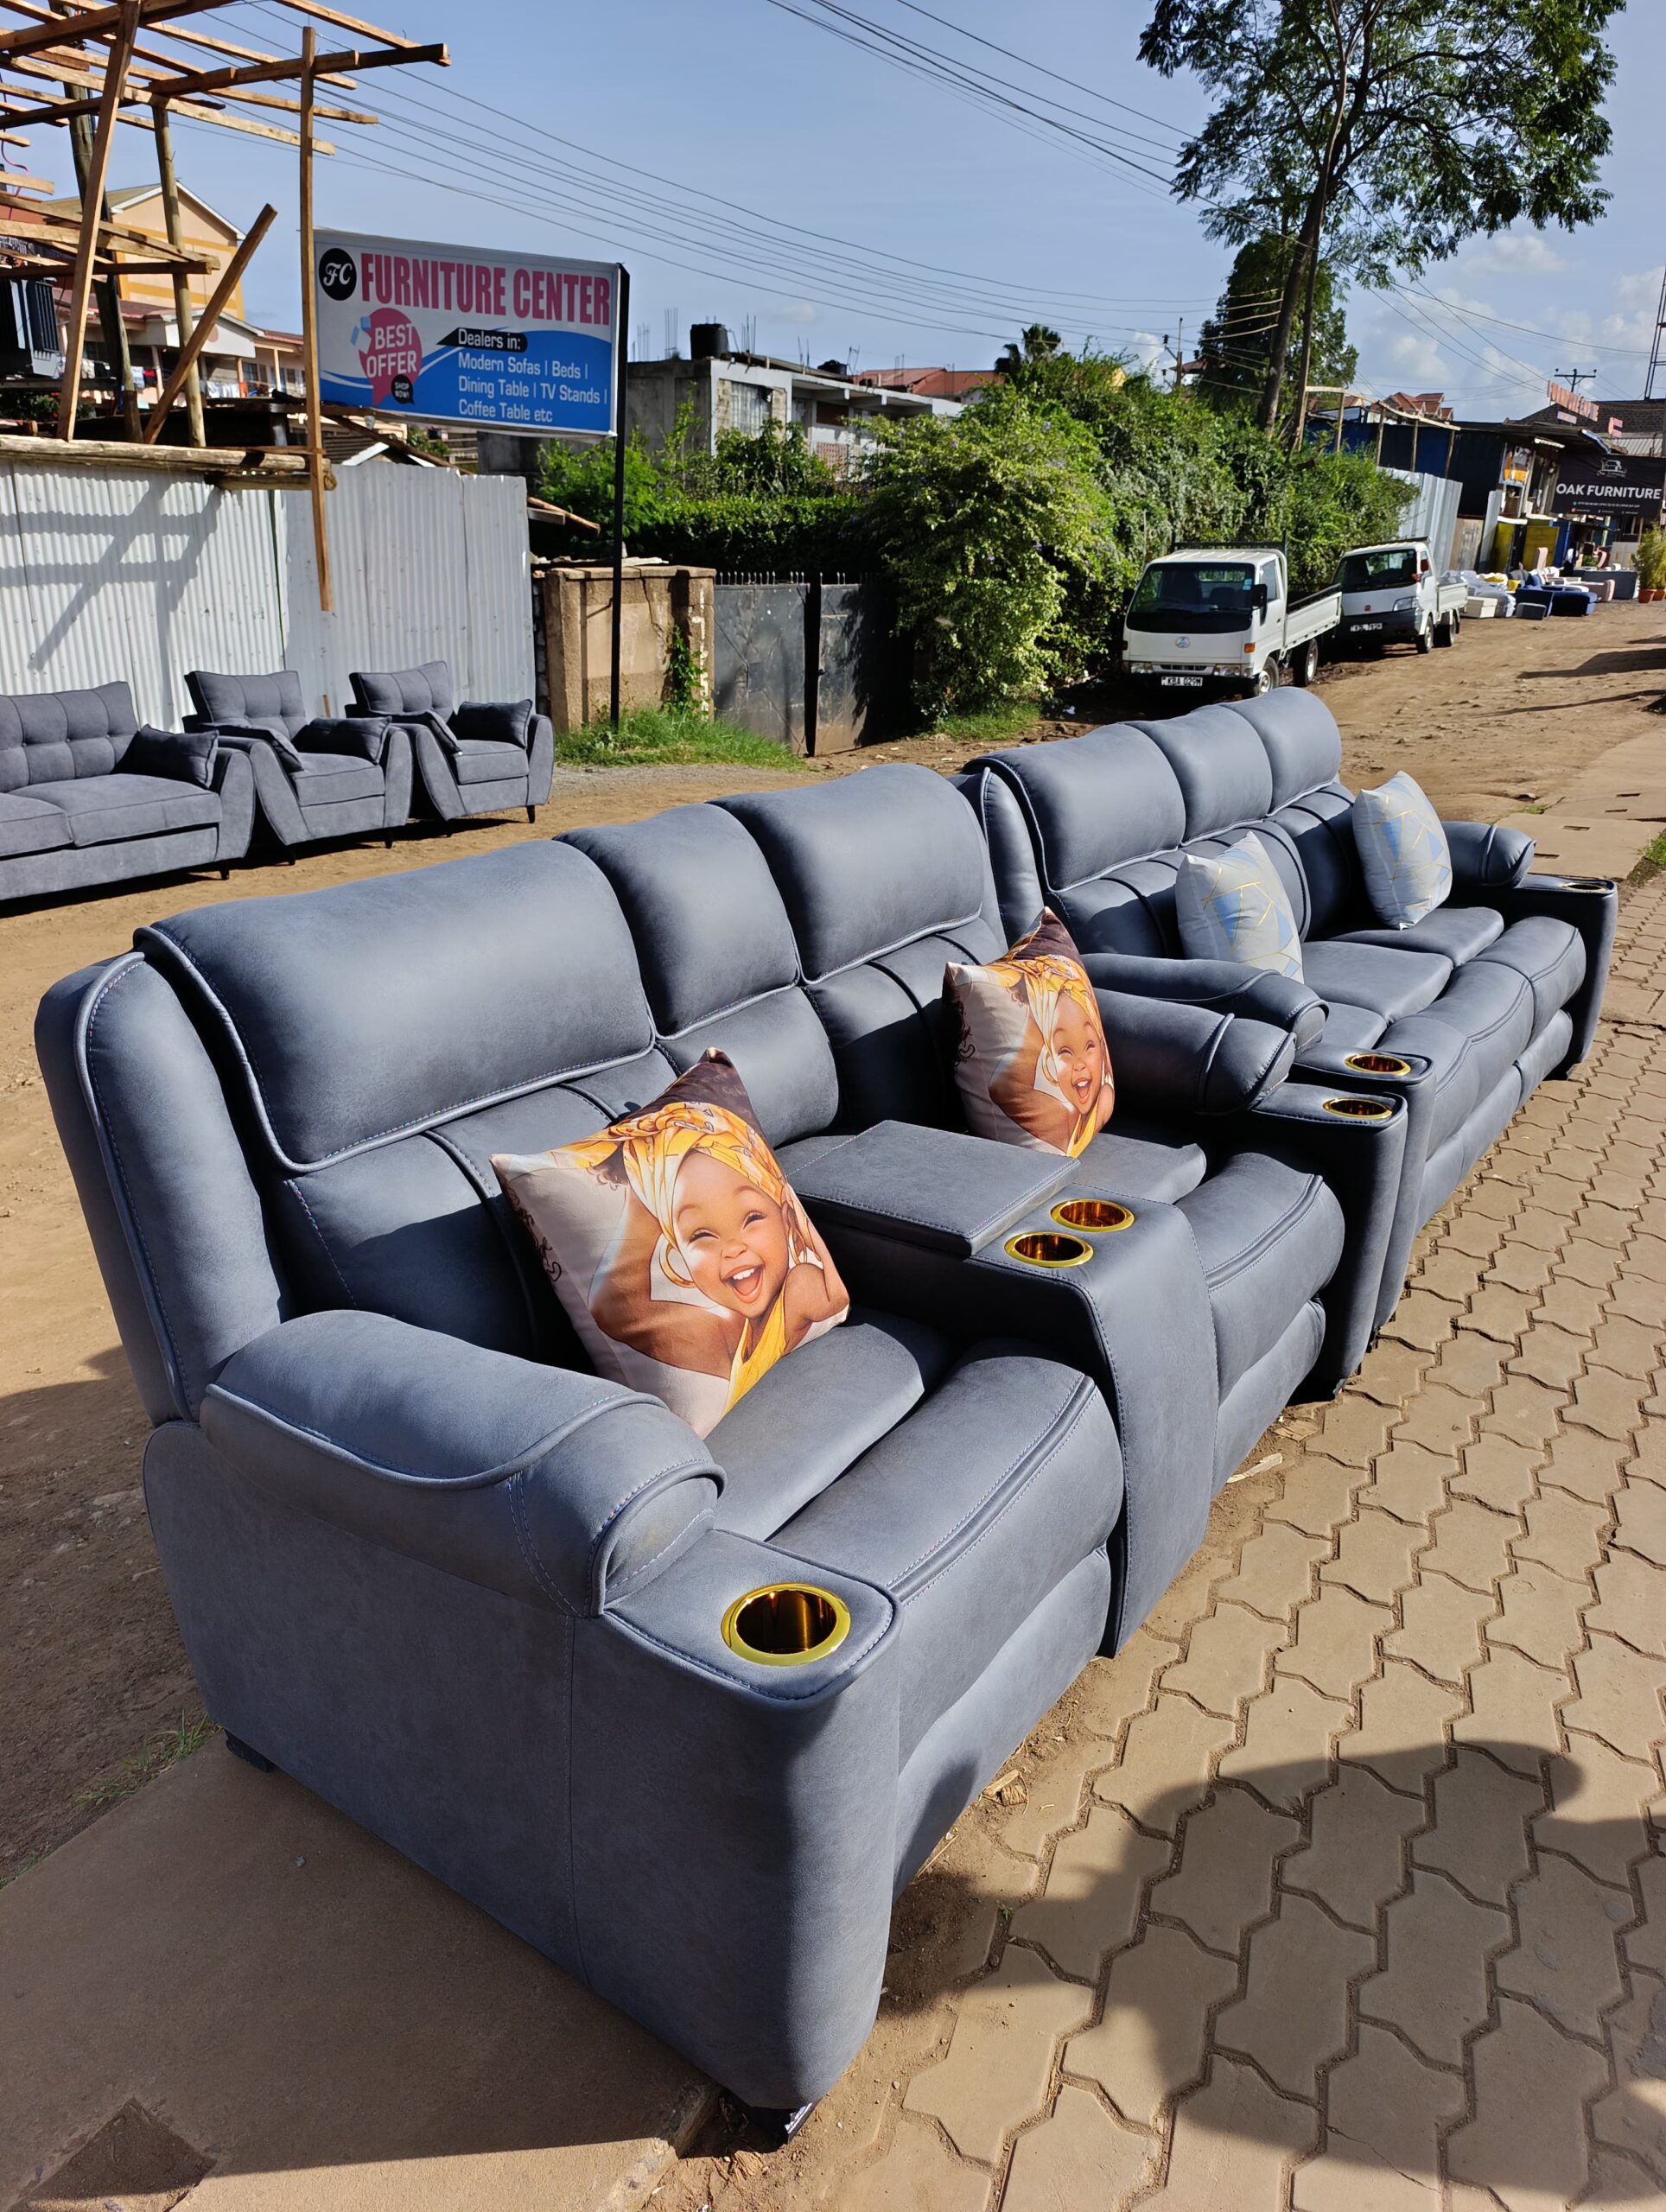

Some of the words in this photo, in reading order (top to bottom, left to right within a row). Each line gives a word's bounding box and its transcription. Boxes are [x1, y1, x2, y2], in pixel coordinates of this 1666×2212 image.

[360, 252, 506, 316] FURNITURE
[513, 268, 610, 326] CENTER
[374, 323, 415, 350] BEST
[458, 328, 504, 348] Dealers
[507, 333, 521, 350] in:
[366, 350, 417, 378] OFFER
[458, 352, 504, 372] Modern
[507, 356, 541, 375] Sofas
[551, 360, 581, 378] Beds
[458, 376, 494, 399] Dining
[498, 378, 530, 398] Table
[540, 383, 556, 400] TV
[559, 385, 601, 404] Stands
[458, 398, 496, 418] Coffee
[499, 402, 531, 421] Table
[534, 408, 553, 423] etc
[1555, 483, 1586, 495] OAK
[1587, 485, 1663, 499] FURNITURE
